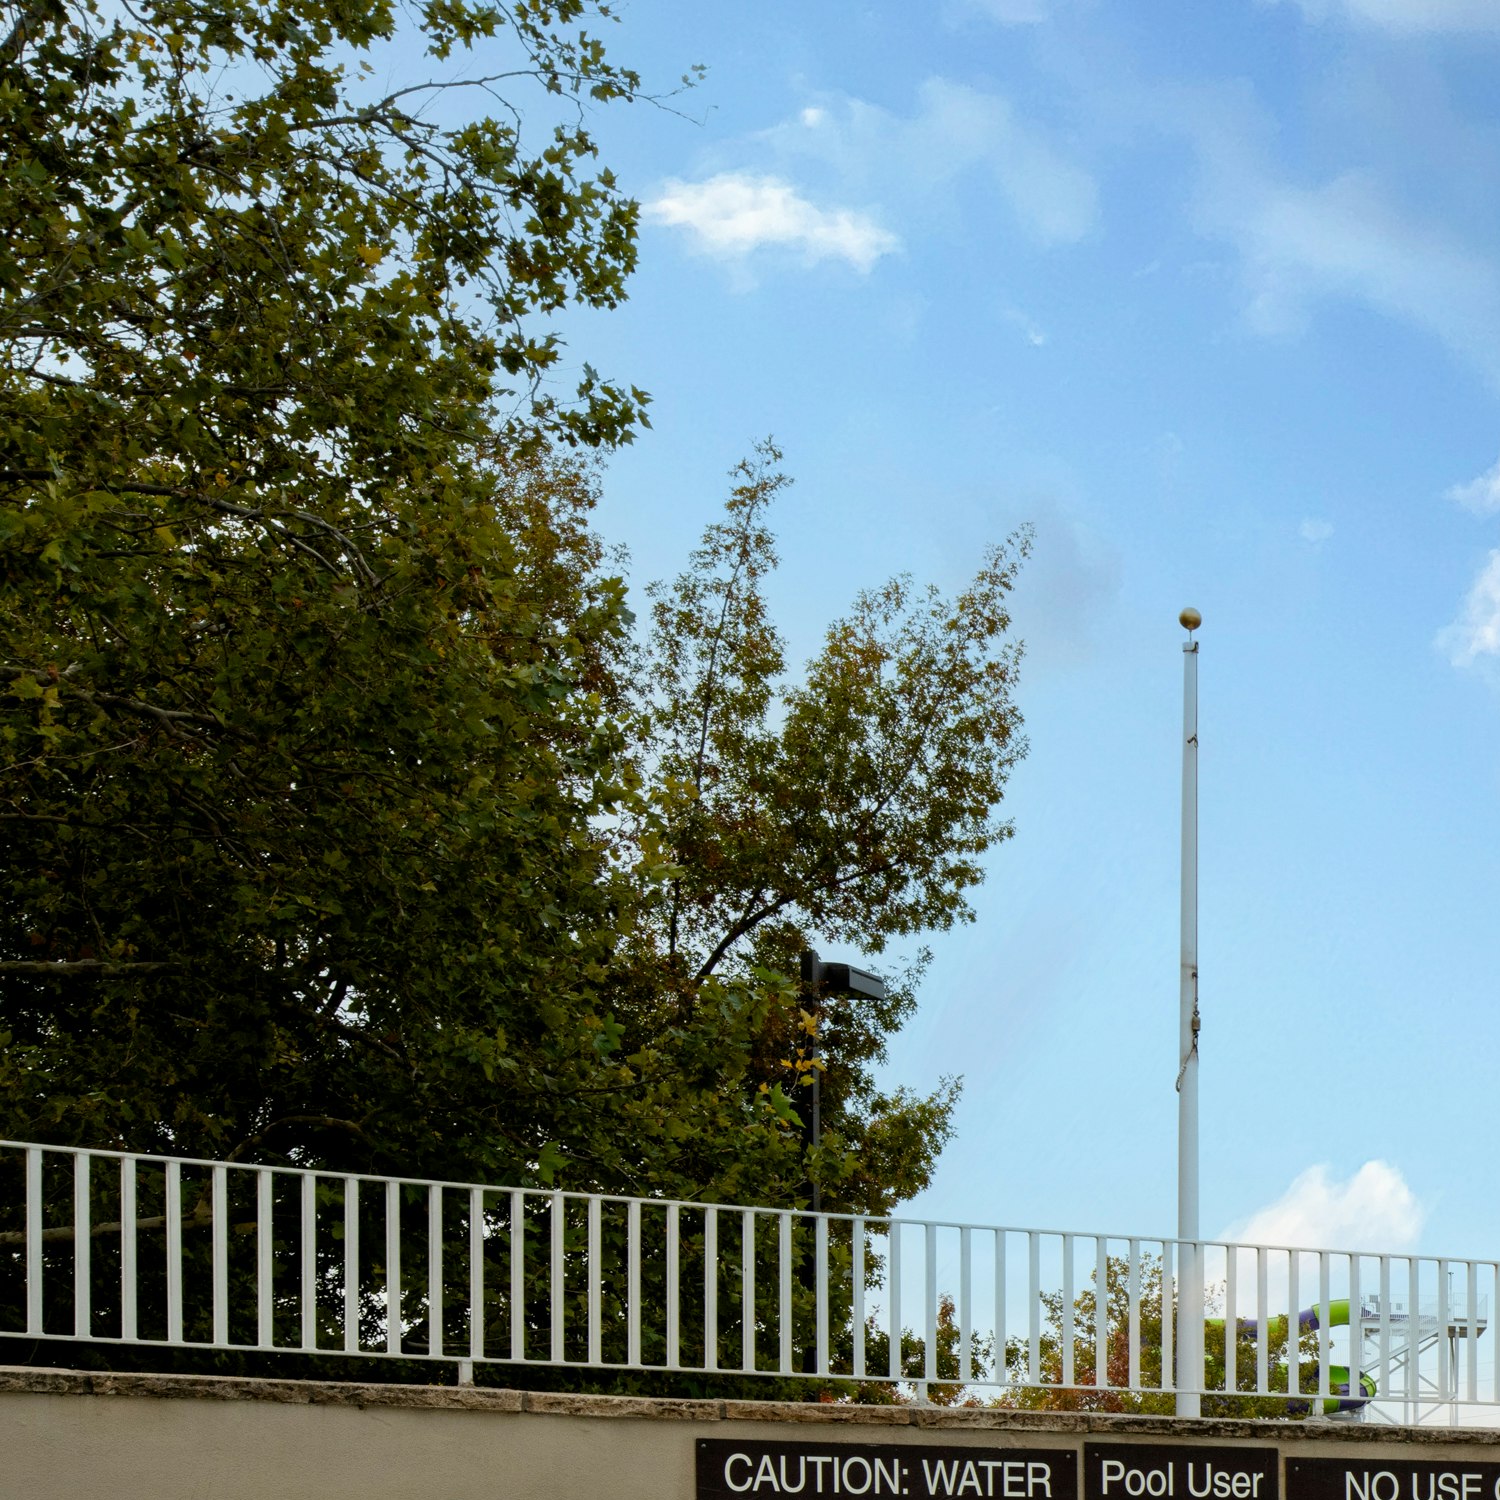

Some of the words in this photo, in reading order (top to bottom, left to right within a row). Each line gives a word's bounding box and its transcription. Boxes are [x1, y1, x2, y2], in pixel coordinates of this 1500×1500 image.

[724, 1453, 908, 1495] CAUTION:
[922, 1459, 1052, 1498] WATER
[1102, 1460, 1173, 1496] Pool
[1188, 1462, 1264, 1498] User
